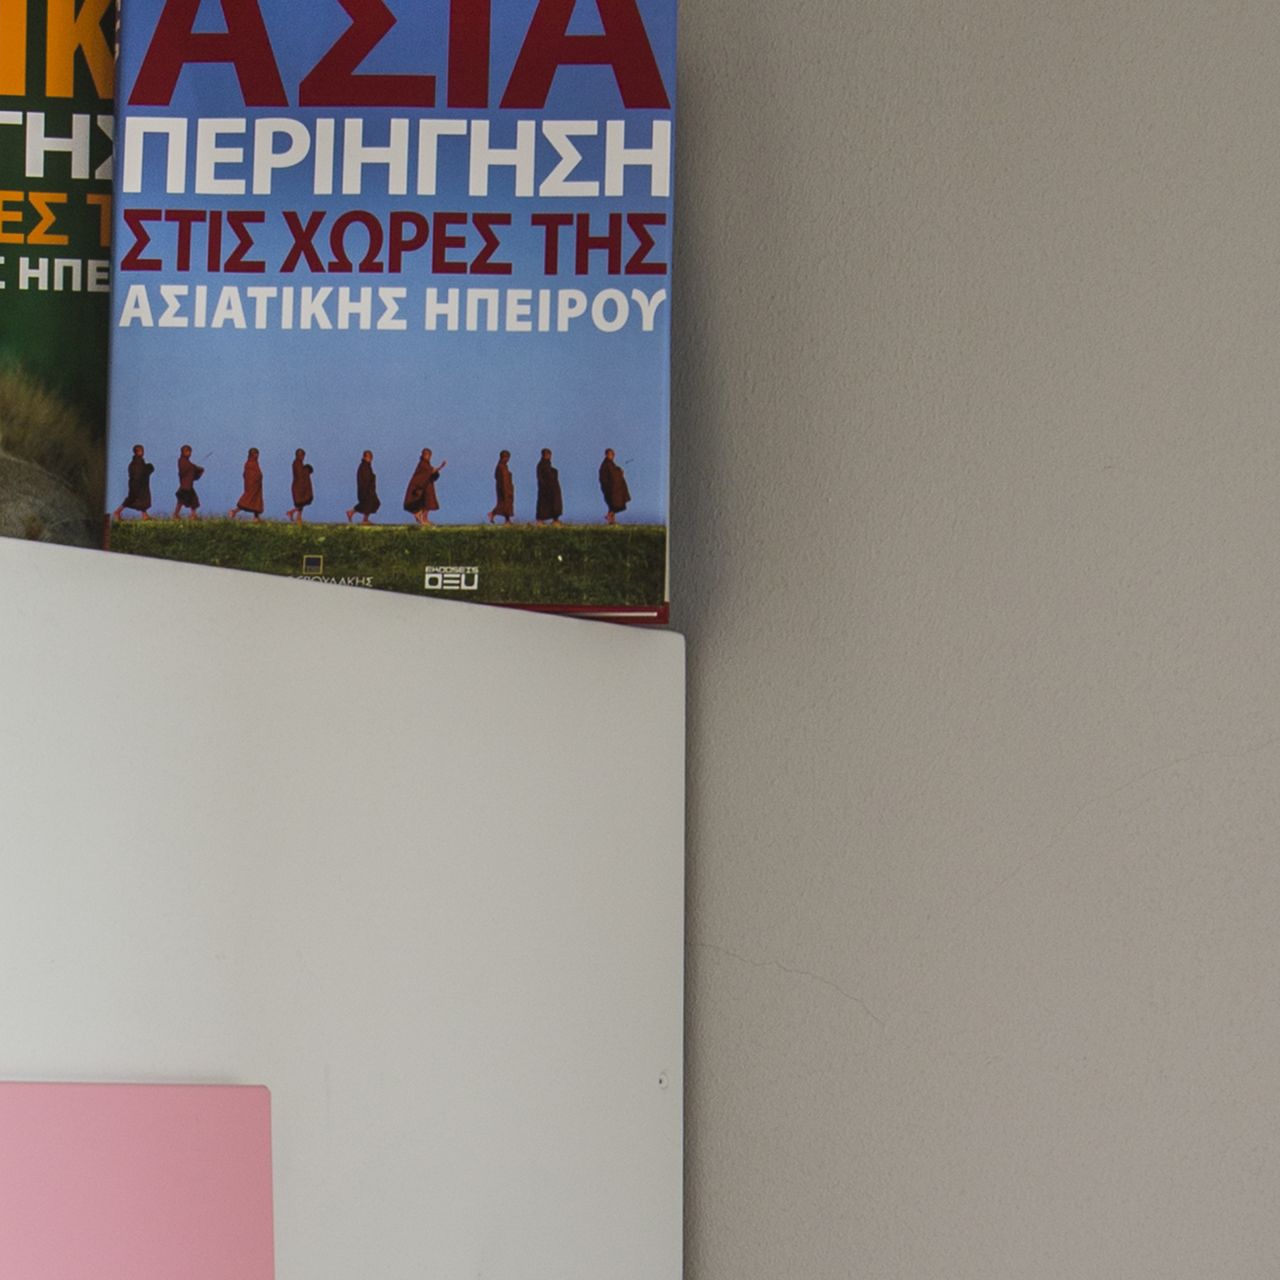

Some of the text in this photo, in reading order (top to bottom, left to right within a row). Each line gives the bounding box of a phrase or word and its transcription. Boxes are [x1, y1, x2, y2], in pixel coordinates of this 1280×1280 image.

[122, 116, 671, 197] ΠΕΡΙΗΓΗΣΗ
[120, 208, 668, 276] ΣΤΙΣ ΧΩΡΕΣ ΤΗΣ
[119, 284, 668, 333] ΑΣΙΑΤΙΚΗΣ ΗΠΕΙΡΟΥ
